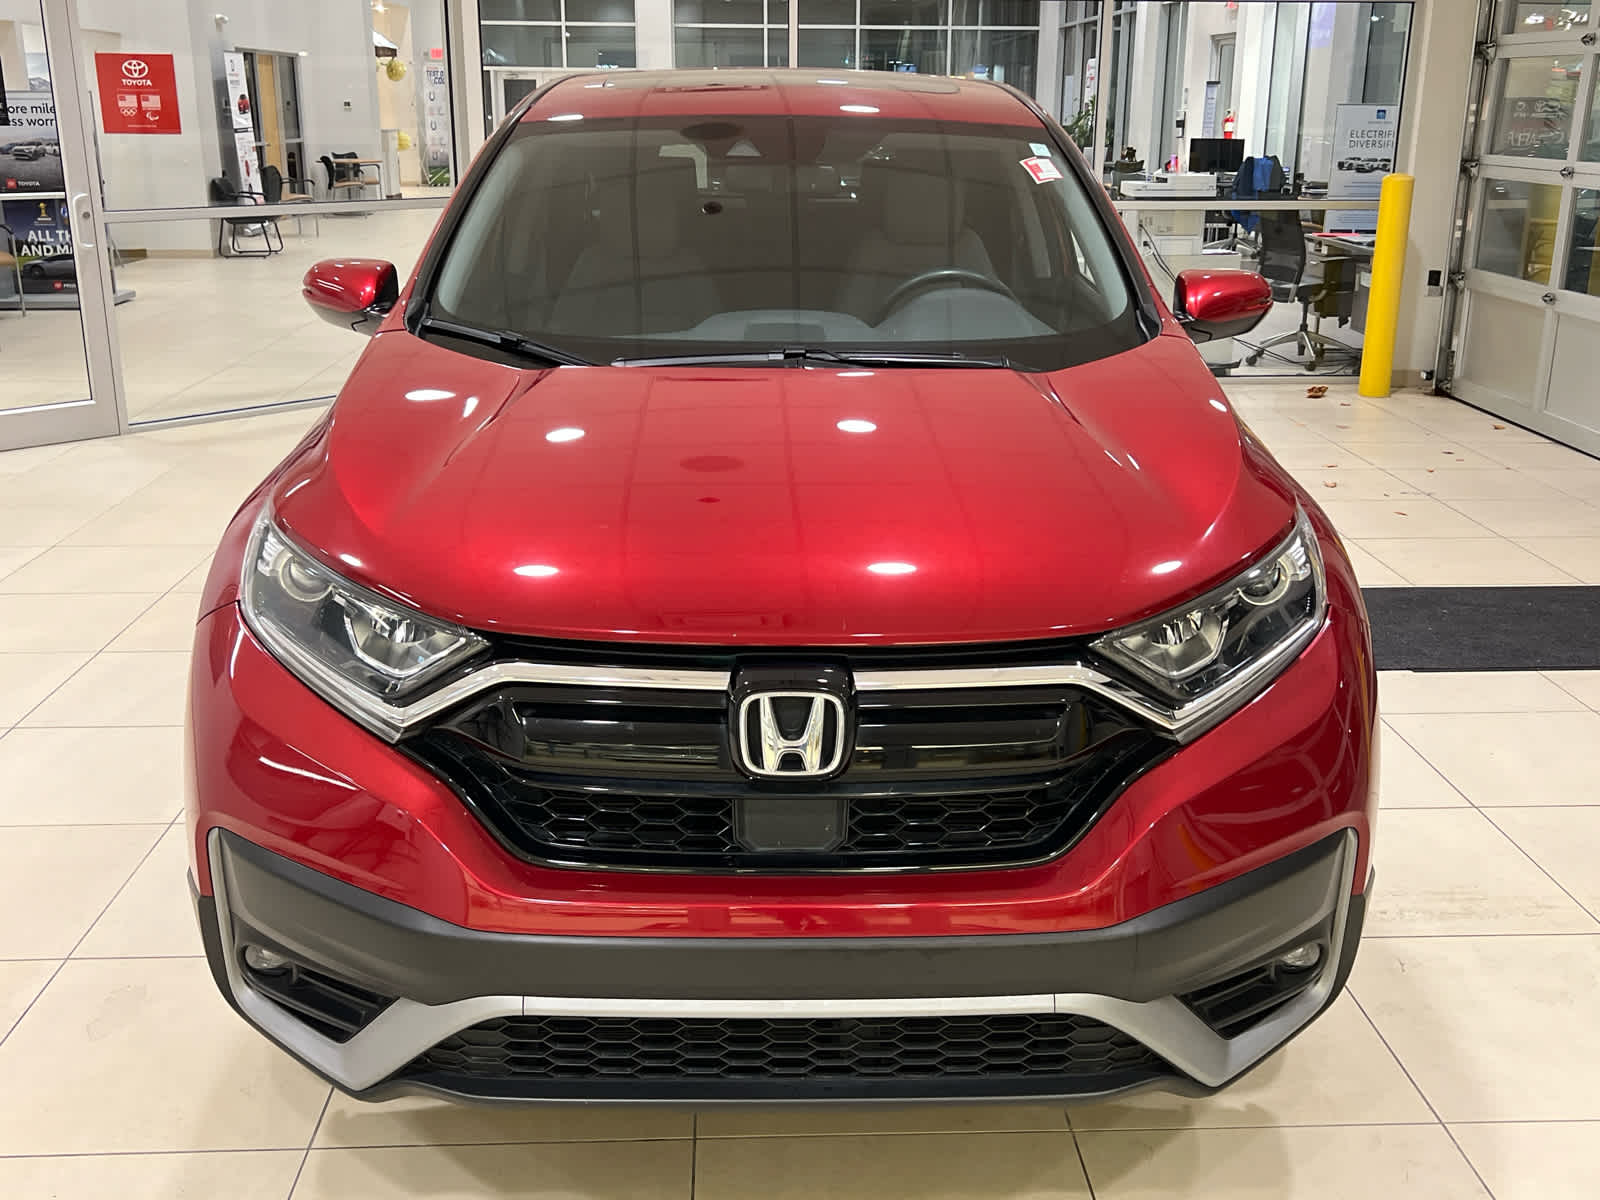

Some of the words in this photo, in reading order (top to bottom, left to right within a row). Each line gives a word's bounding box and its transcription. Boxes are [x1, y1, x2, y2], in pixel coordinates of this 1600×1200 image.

[121, 79, 152, 87] TOYOTA
[7, 105, 28, 114] ore
[26, 118, 55, 126] worr
[1350, 129, 1395, 139] ELECTRIFI
[1348, 140, 1394, 149] DIVERSIFI
[27, 230, 54, 242] ALL
[21, 245, 53, 257] AND
